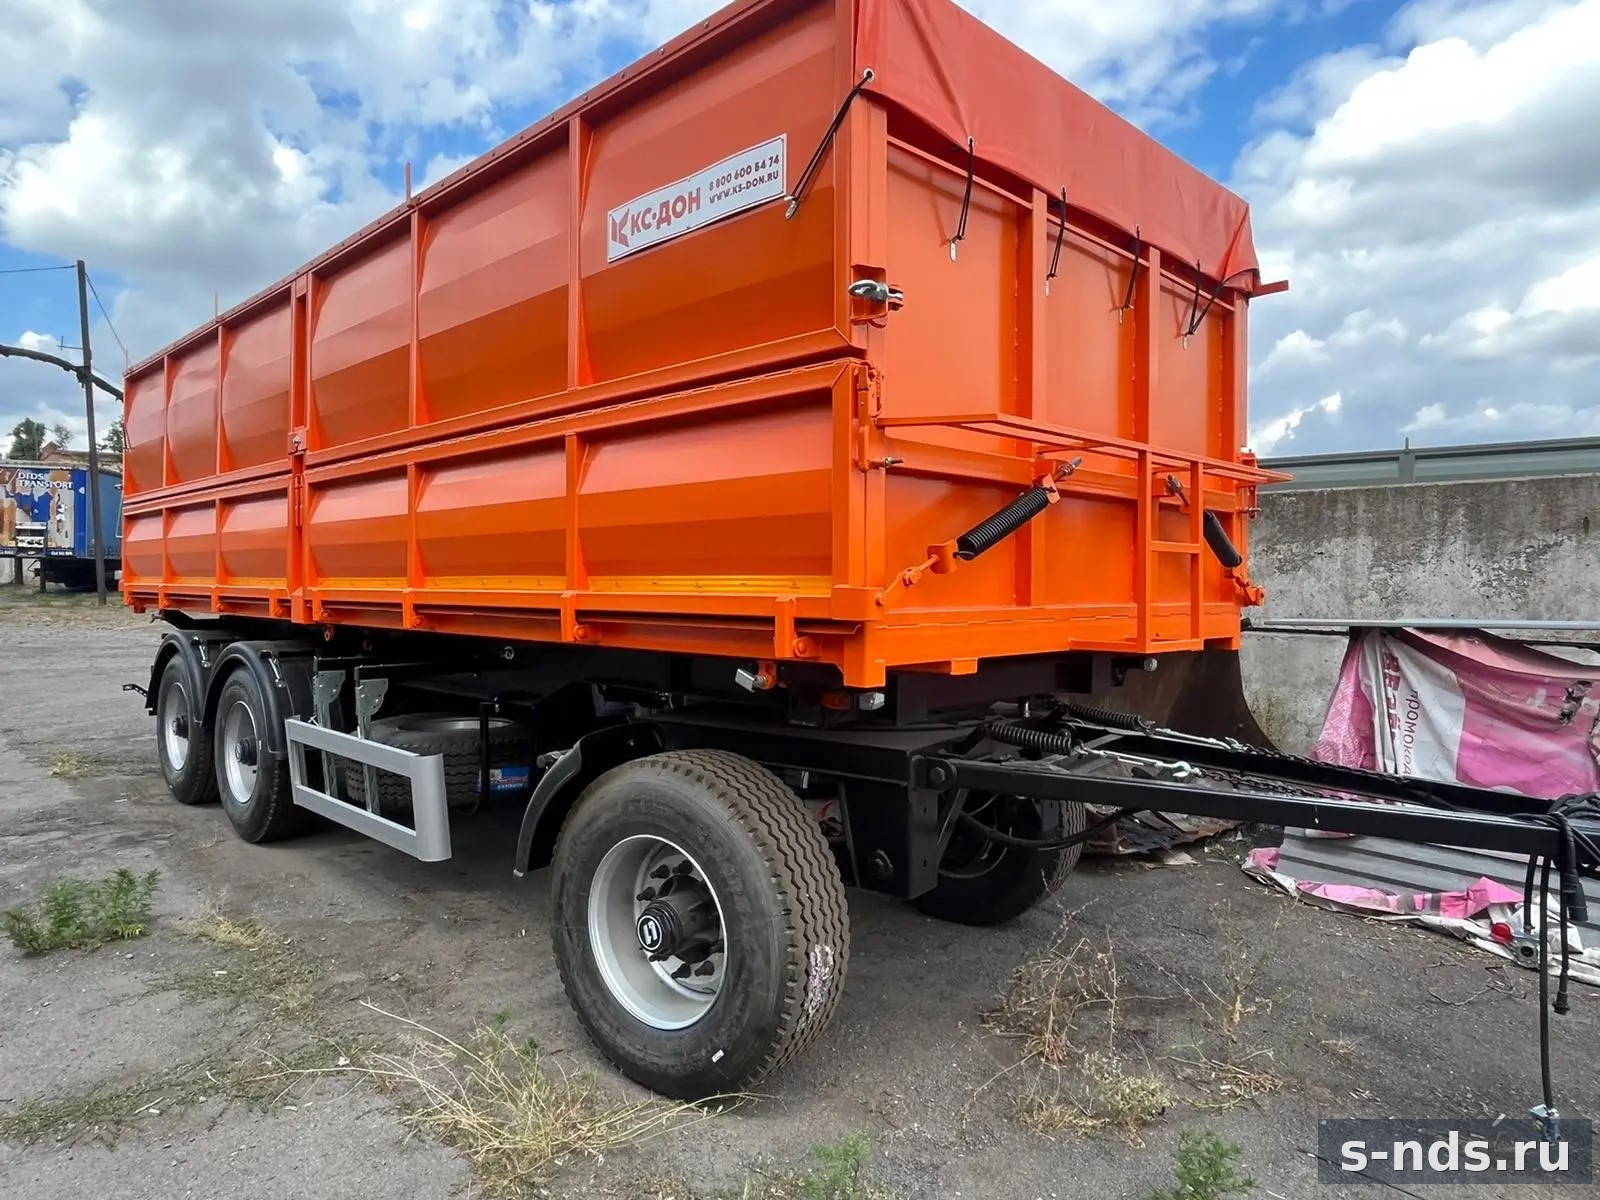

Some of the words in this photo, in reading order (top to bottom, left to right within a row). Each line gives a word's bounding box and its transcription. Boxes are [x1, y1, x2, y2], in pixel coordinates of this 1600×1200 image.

[709, 170, 779, 204] WWW.KS-DON.RU
[715, 173, 732, 189] 800
[734, 164, 752, 180] 600
[768, 154, 780, 168] 74
[19, 480, 73, 489] TRANSPORT
[1402, 689, 1420, 776] промокод
